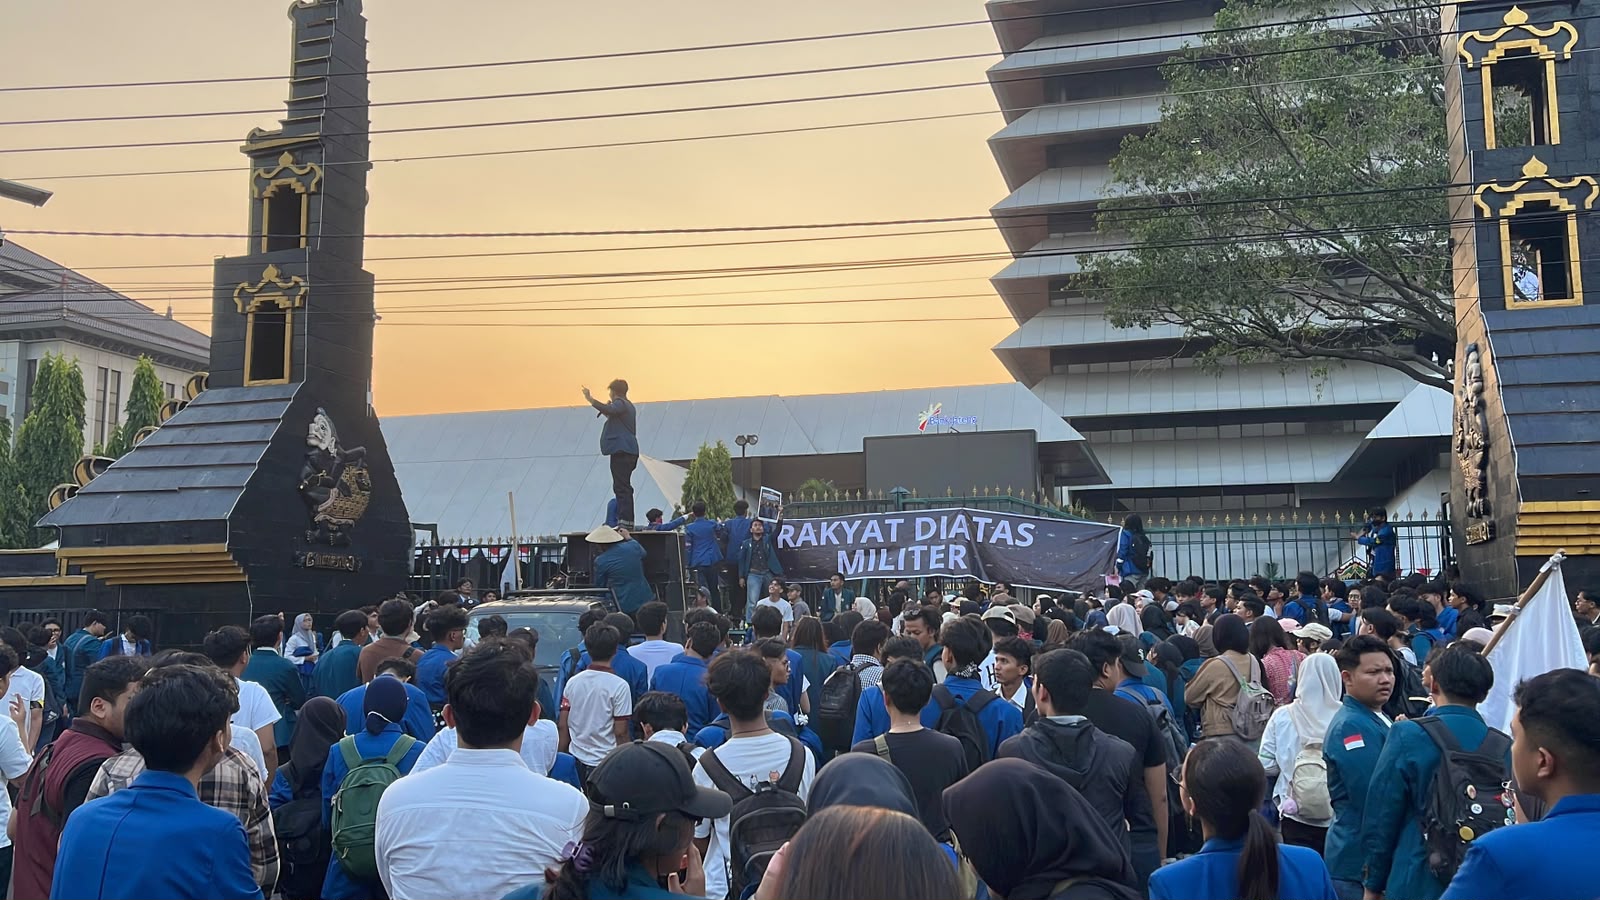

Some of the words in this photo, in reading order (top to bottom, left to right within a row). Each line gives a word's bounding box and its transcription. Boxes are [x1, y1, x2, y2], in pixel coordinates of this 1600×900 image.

[778, 518, 904, 549] RAKYAT
[915, 514, 1036, 547] DIATAS
[837, 544, 967, 574] MILITER
